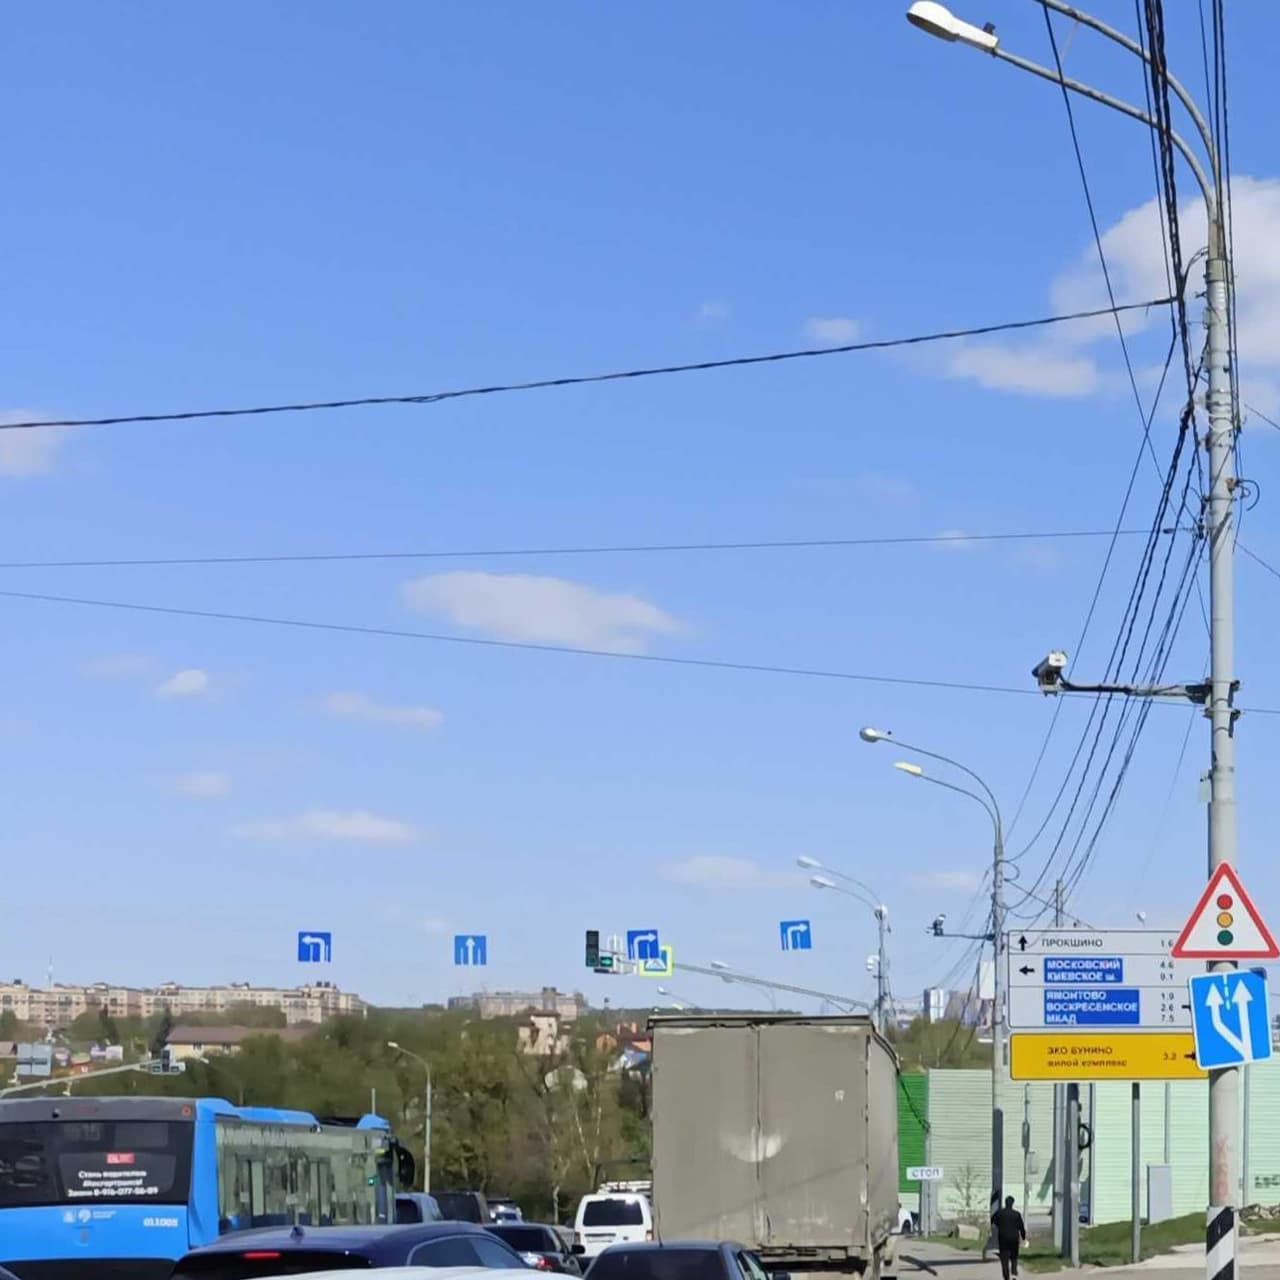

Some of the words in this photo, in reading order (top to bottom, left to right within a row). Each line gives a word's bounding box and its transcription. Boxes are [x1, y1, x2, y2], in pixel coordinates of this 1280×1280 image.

[1042, 938, 1103, 947] ПРОКШИНО
[1047, 959, 1120, 969] МОСКОВСКИЙ
[1047, 971, 1103, 981] КИЕВСКОЕ
[1047, 1002, 1137, 1012] ВОСКРЕСЕНСКОЕ
[1047, 1014, 1077, 1023] МКАД
[1047, 1047, 1068, 1055] ЭКО
[1071, 1047, 1112, 1055] БУНИНО
